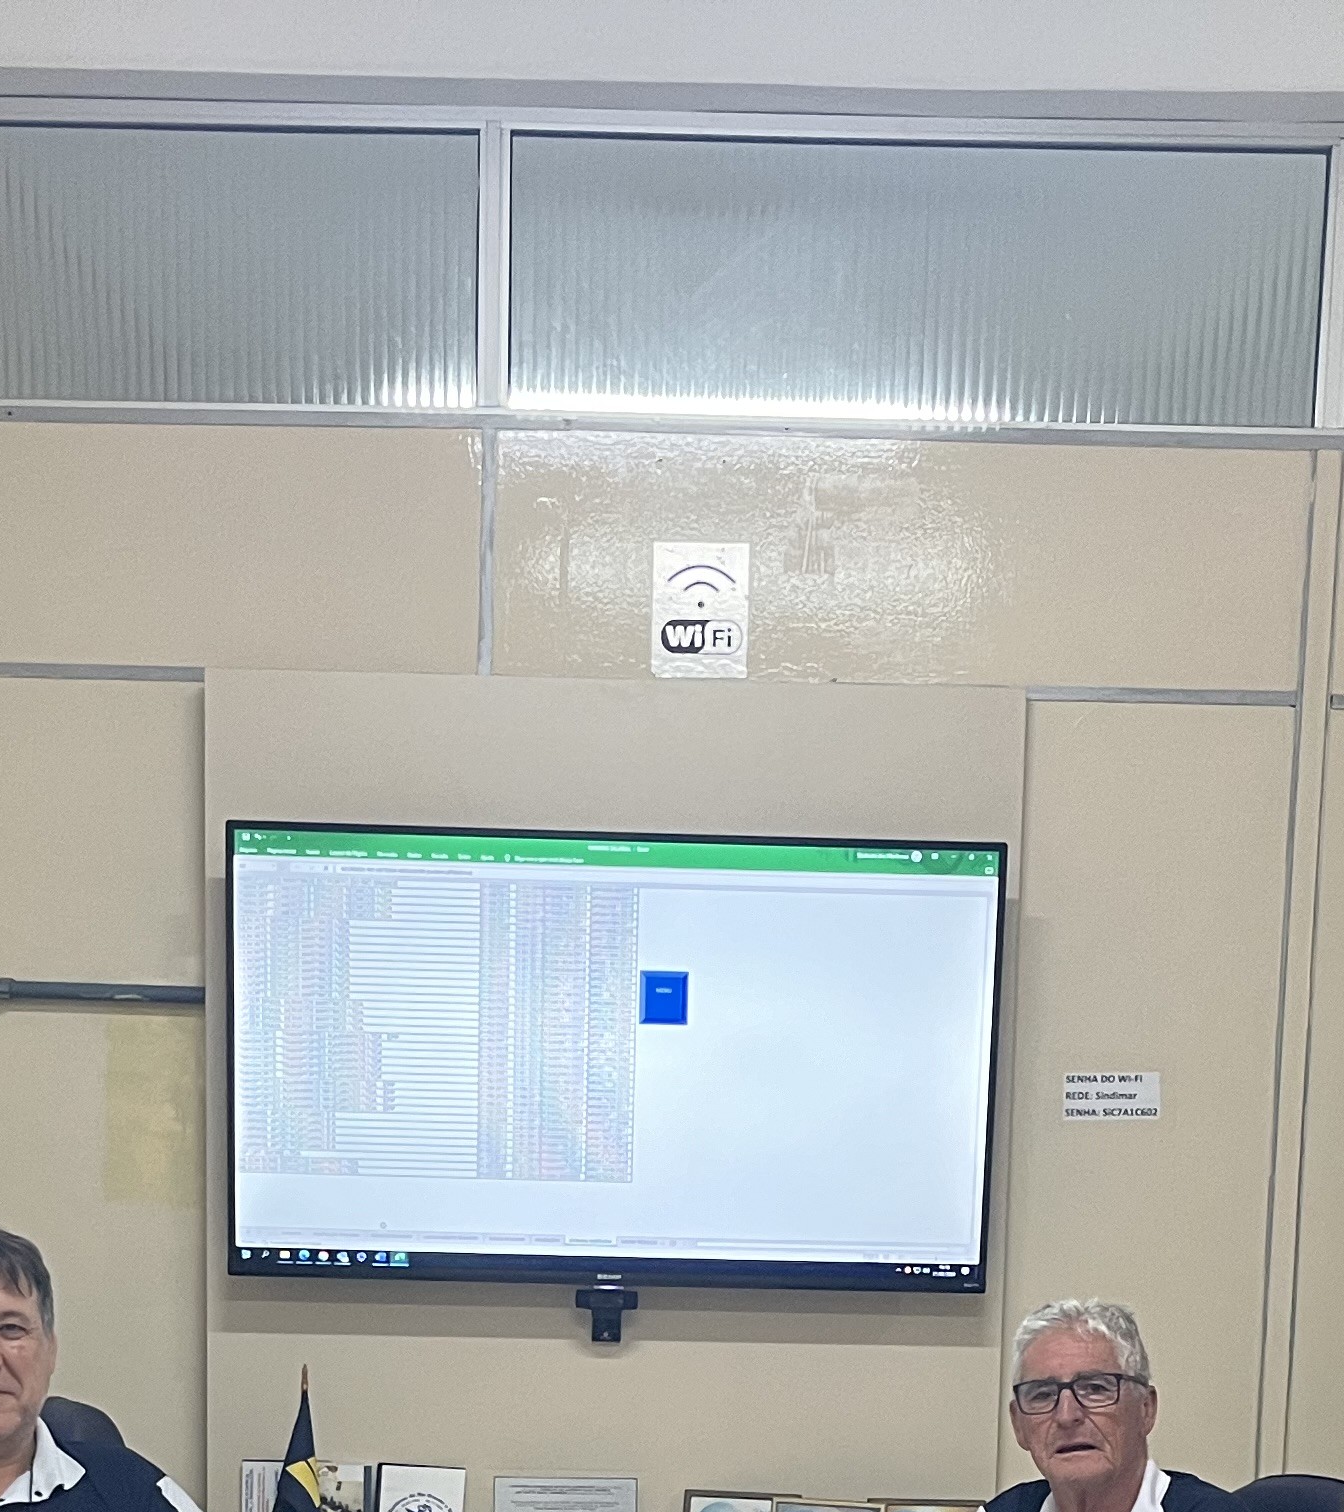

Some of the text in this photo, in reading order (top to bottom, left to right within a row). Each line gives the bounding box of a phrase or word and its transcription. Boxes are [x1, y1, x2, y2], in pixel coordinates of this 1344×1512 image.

[1065, 1074, 1143, 1083] SENHA DO WI-FI
[1065, 1091, 1138, 1100] REDE: Sindimar
[1064, 1108, 1100, 1117] SENHA:
